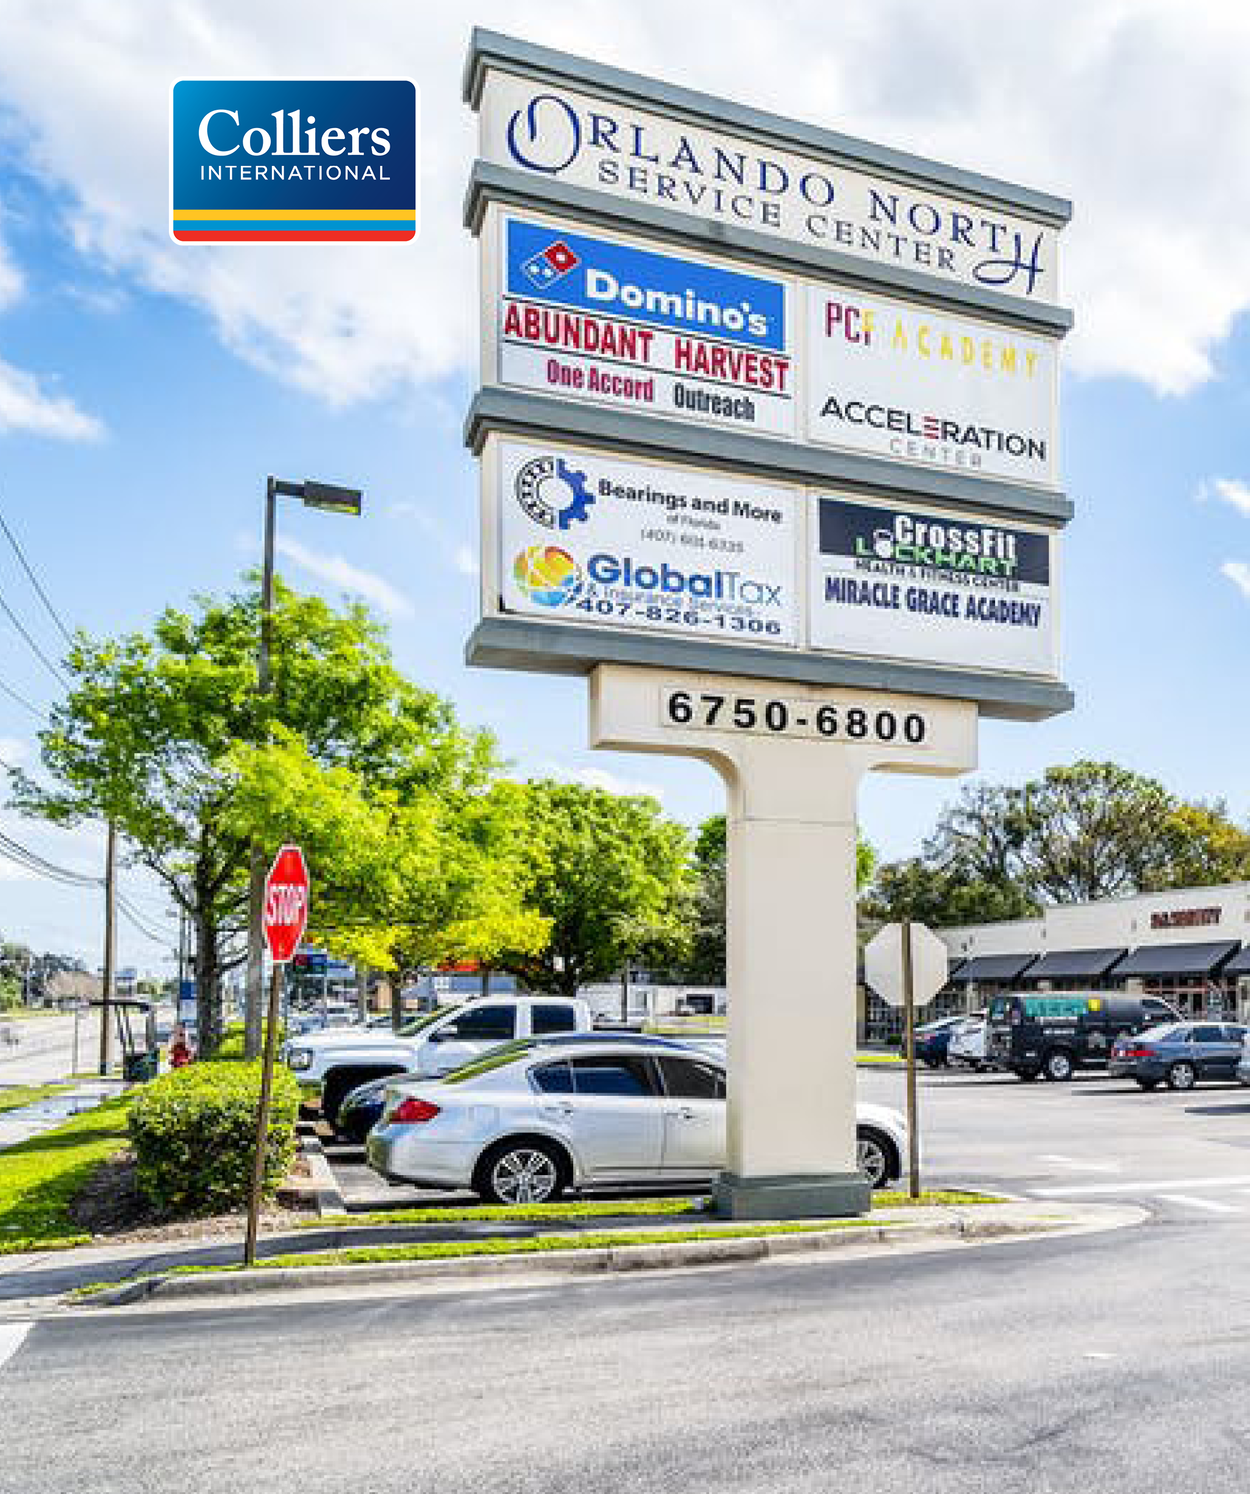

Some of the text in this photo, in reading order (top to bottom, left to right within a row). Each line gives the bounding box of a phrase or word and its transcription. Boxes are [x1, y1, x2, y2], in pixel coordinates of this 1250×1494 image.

[507, 93, 1046, 294] ORLANDO NORTH
[598, 160, 956, 271] SERVICE CENTER
[584, 267, 769, 337] Domino's
[503, 302, 790, 391] ABUNDANT HARVEST
[892, 316, 1039, 377] ACADEMY
[547, 359, 756, 422] One Accord Outreach
[820, 396, 1046, 460] ACCELERATION
[889, 438, 982, 468] CENTER
[599, 478, 783, 524] Bearings and More
[895, 514, 1016, 559] CrossFit
[587, 554, 781, 606] GlobalTax
[825, 576, 1041, 628] MIRACLE GRACE ACADEMY
[576, 599, 781, 635] 407-826-1306
[668, 691, 925, 743] 6750-6800
[265, 884, 307, 926] STOP
